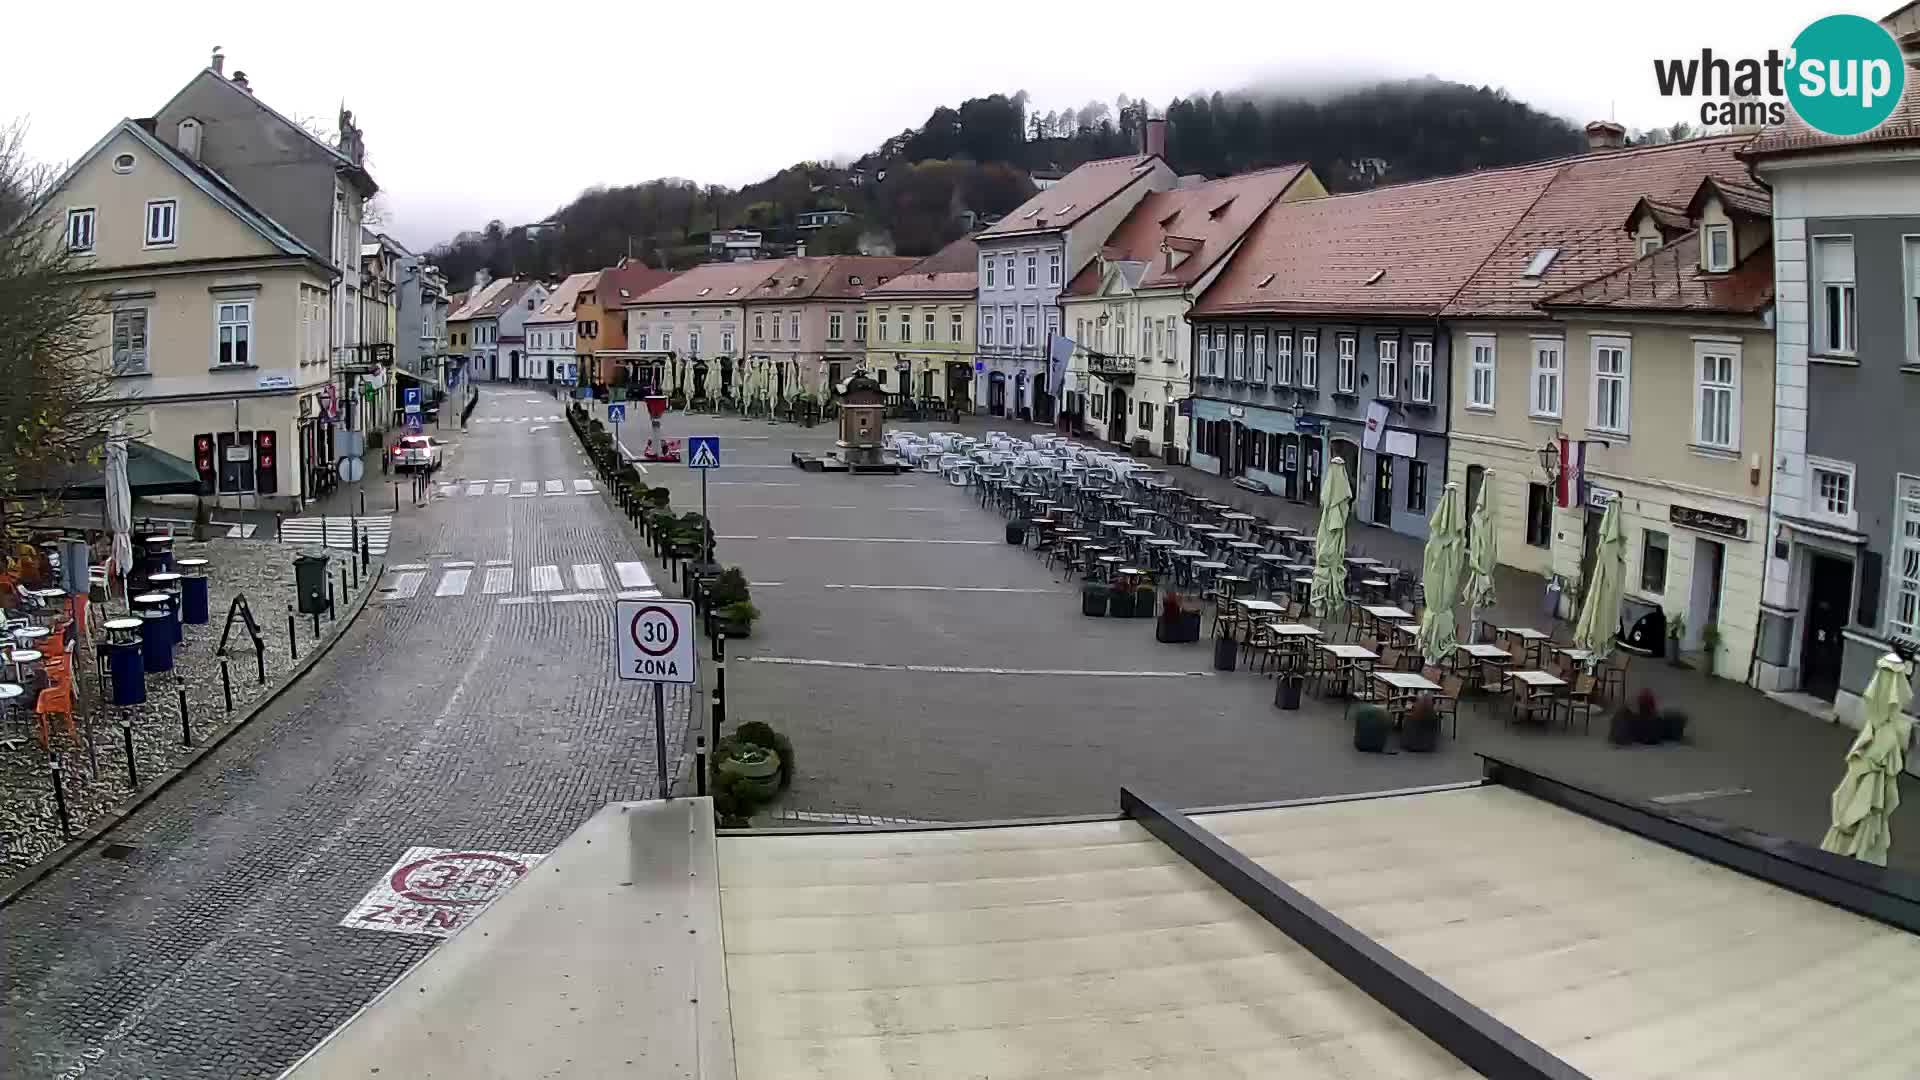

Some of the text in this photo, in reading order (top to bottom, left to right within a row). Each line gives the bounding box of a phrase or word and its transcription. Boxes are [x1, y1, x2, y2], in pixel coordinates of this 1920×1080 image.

[643, 621, 668, 643] 30
[634, 659, 679, 676] ZONA
[359, 904, 465, 928] ZON
